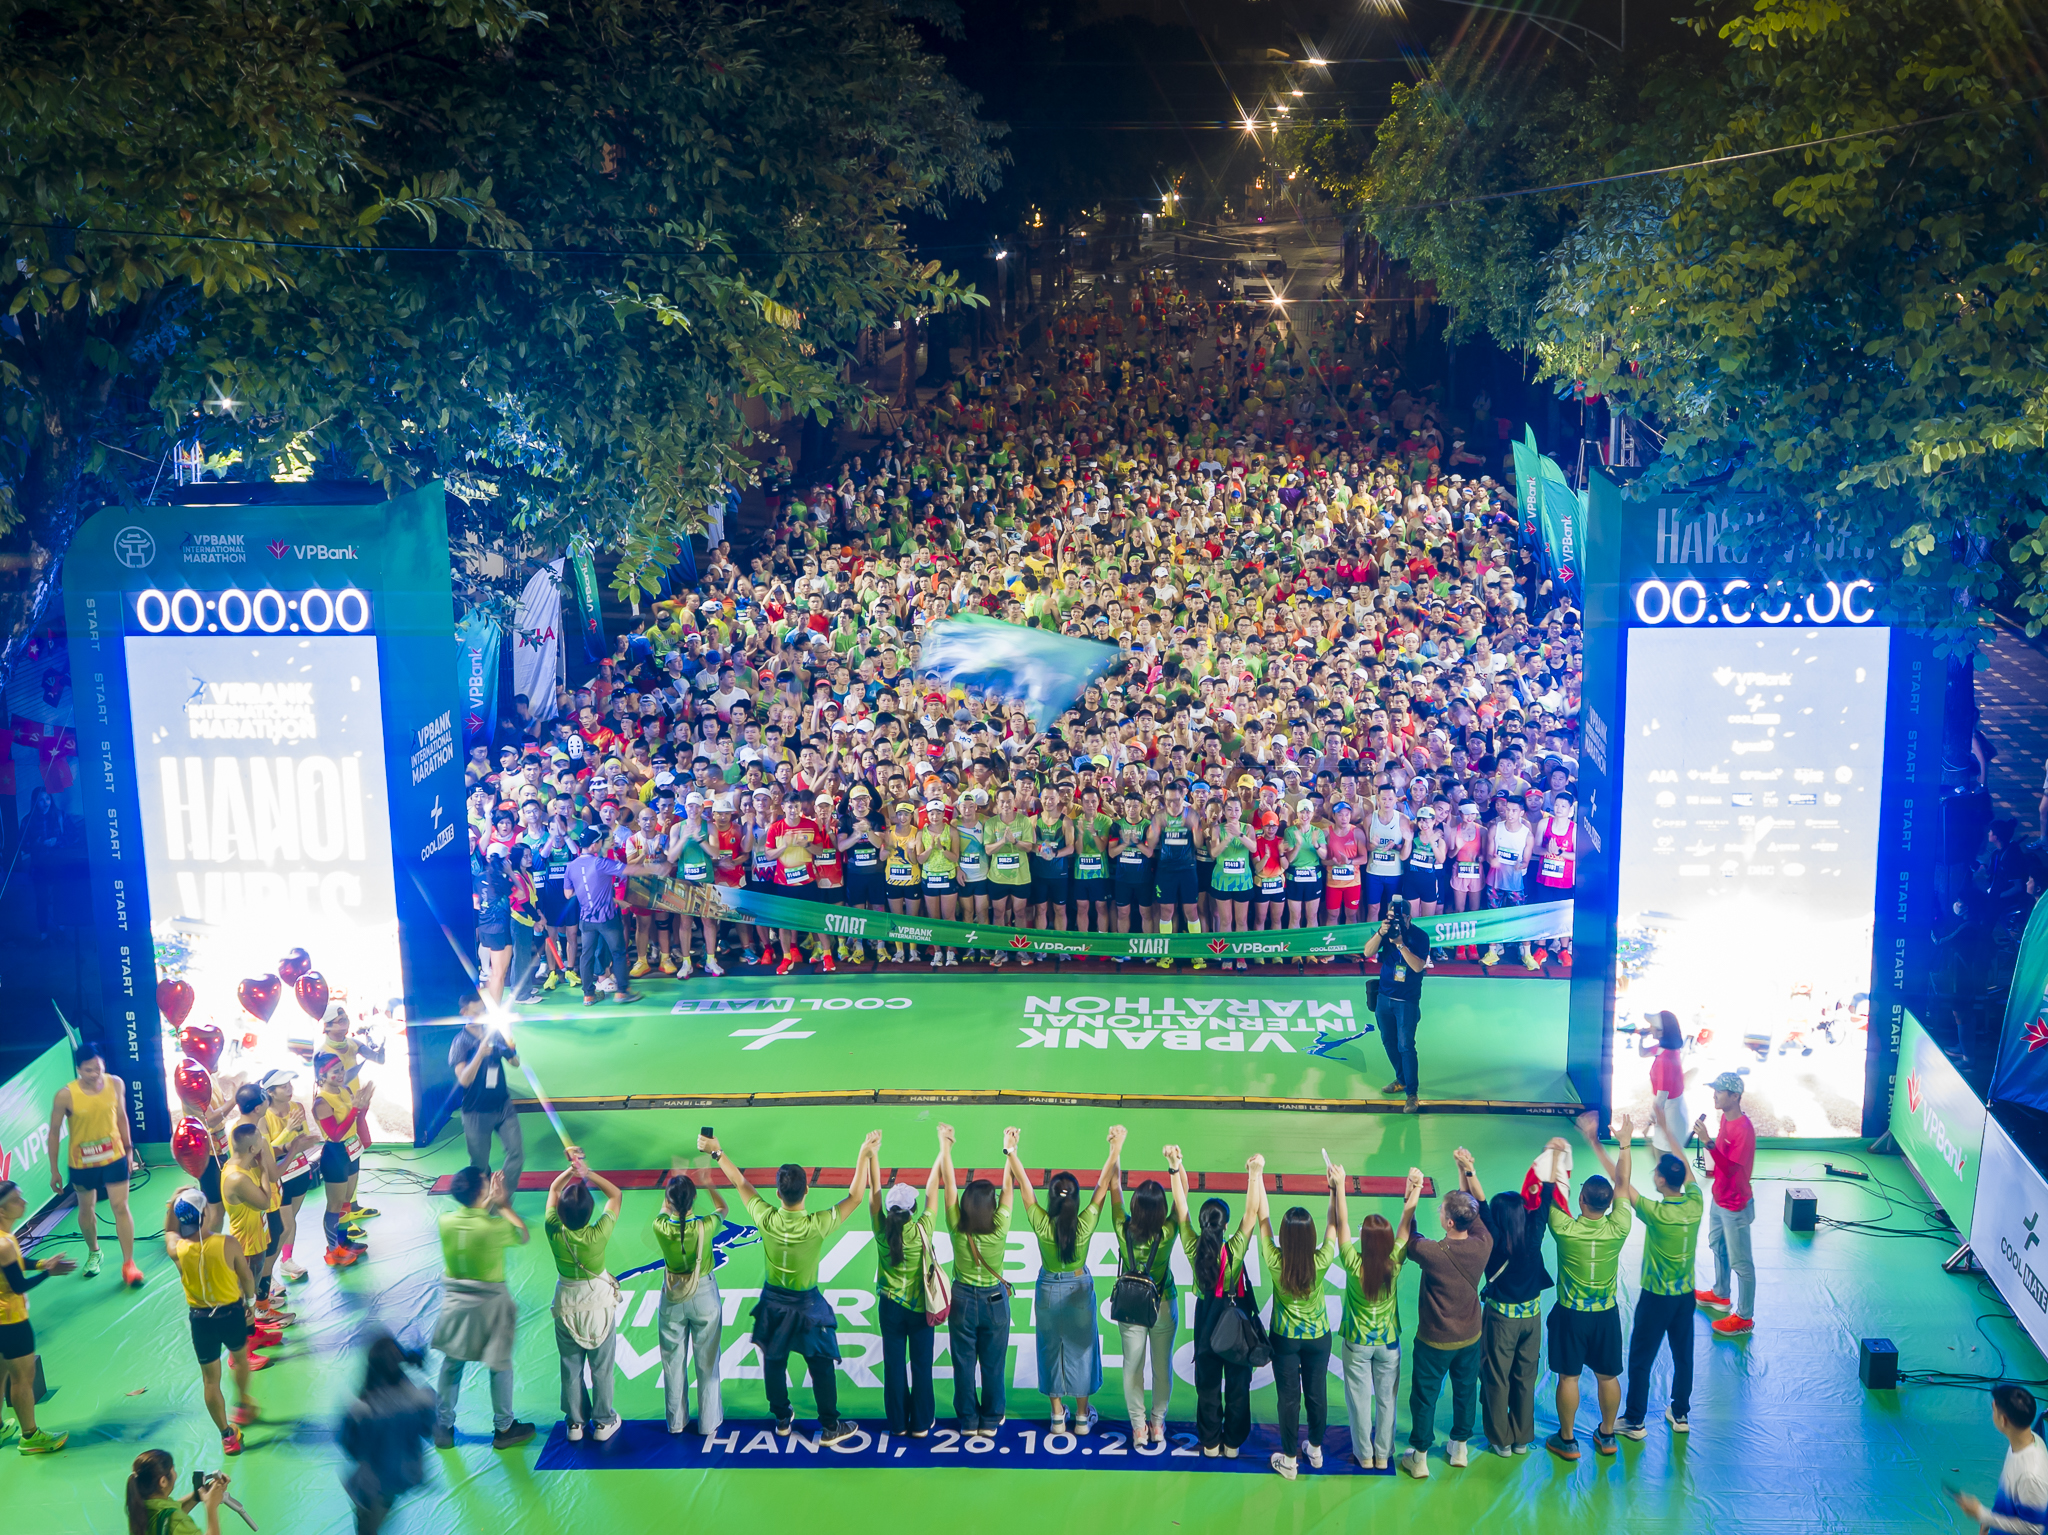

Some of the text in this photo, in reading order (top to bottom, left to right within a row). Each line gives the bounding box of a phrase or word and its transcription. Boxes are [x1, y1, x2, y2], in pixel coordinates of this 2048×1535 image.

[1526, 476, 1537, 519] VPBank
[182, 545, 245, 553] INTERNATIONAL
[183, 553, 247, 563] MARATHON
[193, 534, 245, 546] VPBANK
[293, 544, 360, 560] VPBank
[1560, 515, 1574, 562] VPBank
[86, 598, 100, 652] START
[136, 588, 369, 633] 00:00:00
[94, 673, 108, 725] START
[208, 682, 315, 704] VPBANK
[467, 647, 484, 709] VPBank
[1910, 661, 1922, 715] START
[190, 719, 317, 739] MARATHON
[410, 731, 453, 769] INTERNATIONAL
[418, 709, 452, 749] VPBANK
[101, 741, 115, 793] START
[412, 743, 454, 787] MARATHON
[1905, 730, 1918, 783] START
[159, 756, 367, 862] HANOI
[1901, 799, 1914, 851] START
[107, 808, 121, 860] START
[114, 880, 128, 931] START
[1897, 871, 1909, 923] START
[898, 926, 933, 936] VPBANK
[1128, 938, 1171, 955] START
[1231, 941, 1290, 954] VPBank
[1434, 920, 1478, 942] START
[120, 946, 134, 997] START
[1894, 938, 1906, 989] START
[1023, 995, 1354, 1018] MARATHON
[1023, 1013, 1357, 1032] INTERNATIONAL
[126, 1011, 139, 1062] START
[1016, 1027, 1298, 1053] VPBANK
[1890, 1004, 1902, 1055] START
[132, 1080, 146, 1131] START
[1923, 1100, 1964, 1182] VPBank
[701, 1429, 907, 1459] HANOI,
